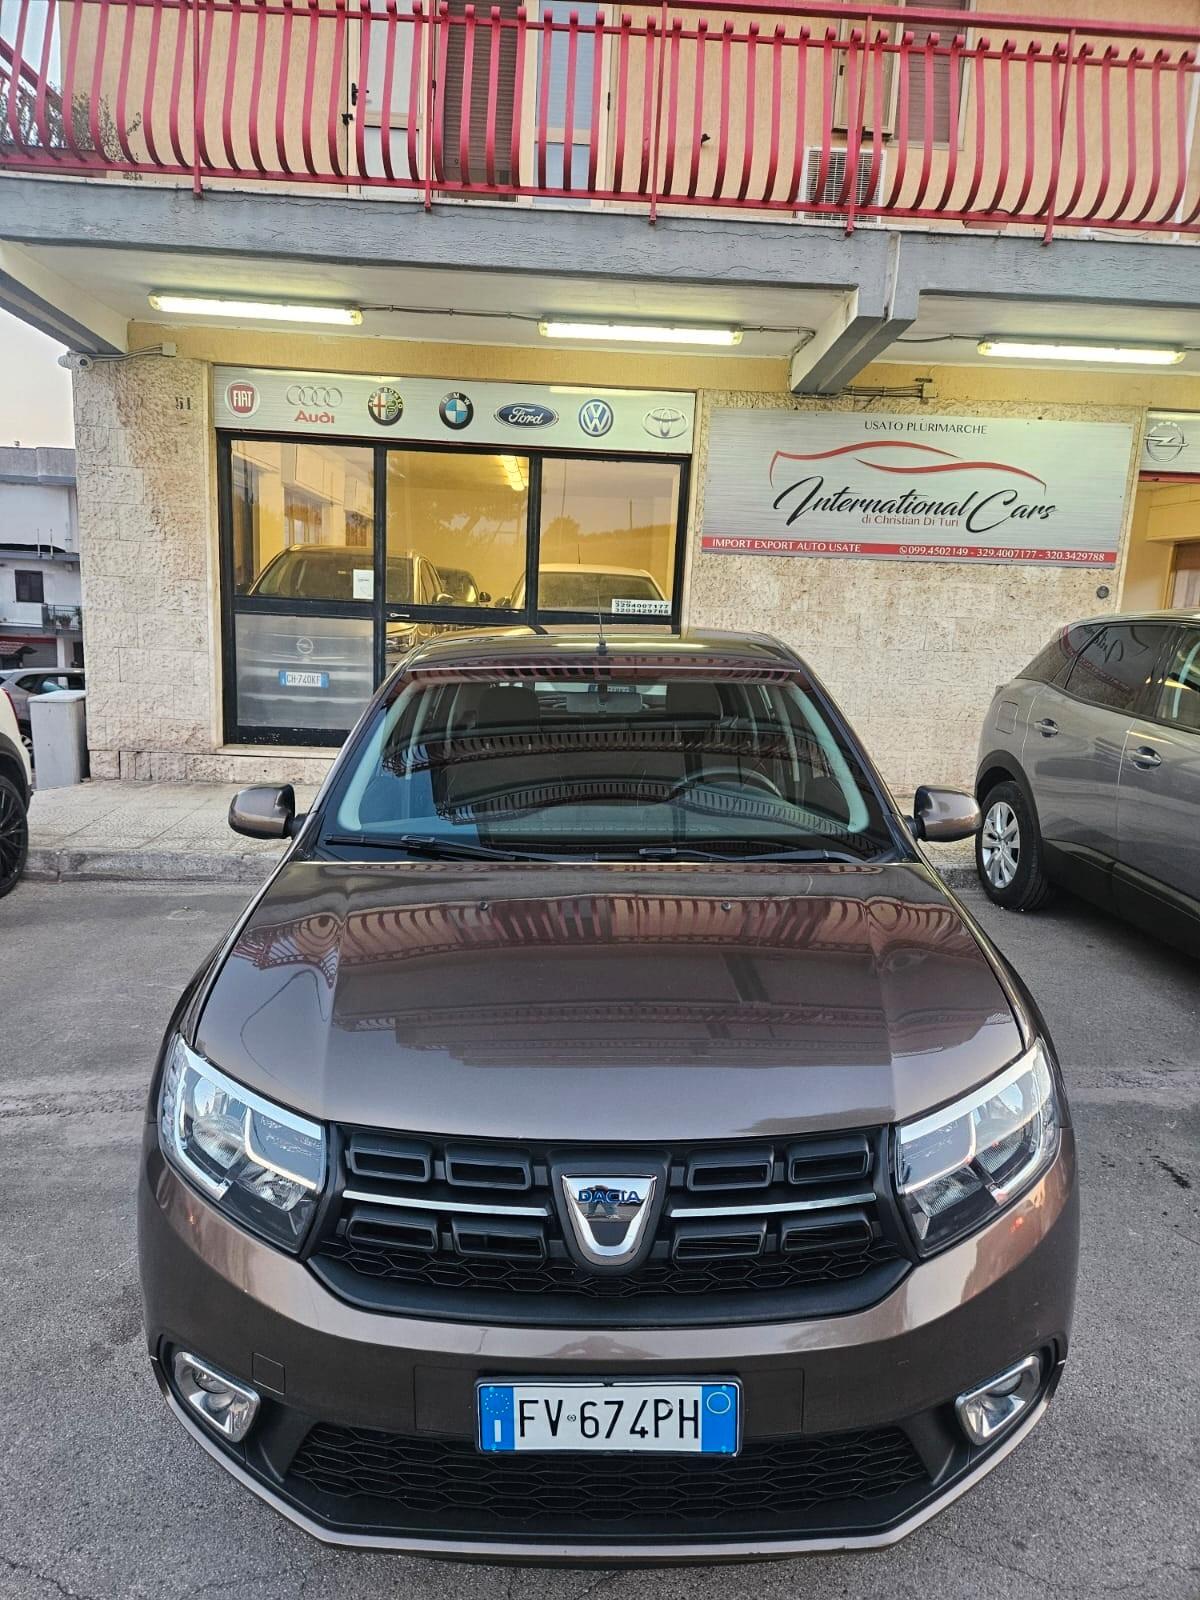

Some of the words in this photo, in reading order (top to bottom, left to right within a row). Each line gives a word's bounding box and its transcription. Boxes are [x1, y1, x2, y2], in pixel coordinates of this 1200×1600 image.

[233, 390, 252, 407] FIAT
[295, 410, 335, 424] Audi
[508, 407, 545, 425] Ford
[864, 420, 904, 432] USATO
[906, 422, 988, 435] PLURIMARCHE
[773, 475, 978, 526] International
[965, 489, 1057, 534] Cars
[862, 514, 872, 524] di
[874, 514, 920, 526] Christian
[923, 515, 936, 526] Di
[939, 516, 960, 528] Turi
[712, 538, 752, 549] IMPORT
[754, 540, 795, 551] EXPORT
[797, 542, 827, 552] AUTO
[829, 543, 861, 553] USATE
[908, 546, 969, 557] 099.4502149
[976, 548, 1038, 560] 329.4007177
[1045, 551, 1105, 562] 320.3429788
[578, 1190, 641, 1204] DACIA
[518, 1399, 563, 1438] FV
[579, 1398, 699, 1439] 674PH
